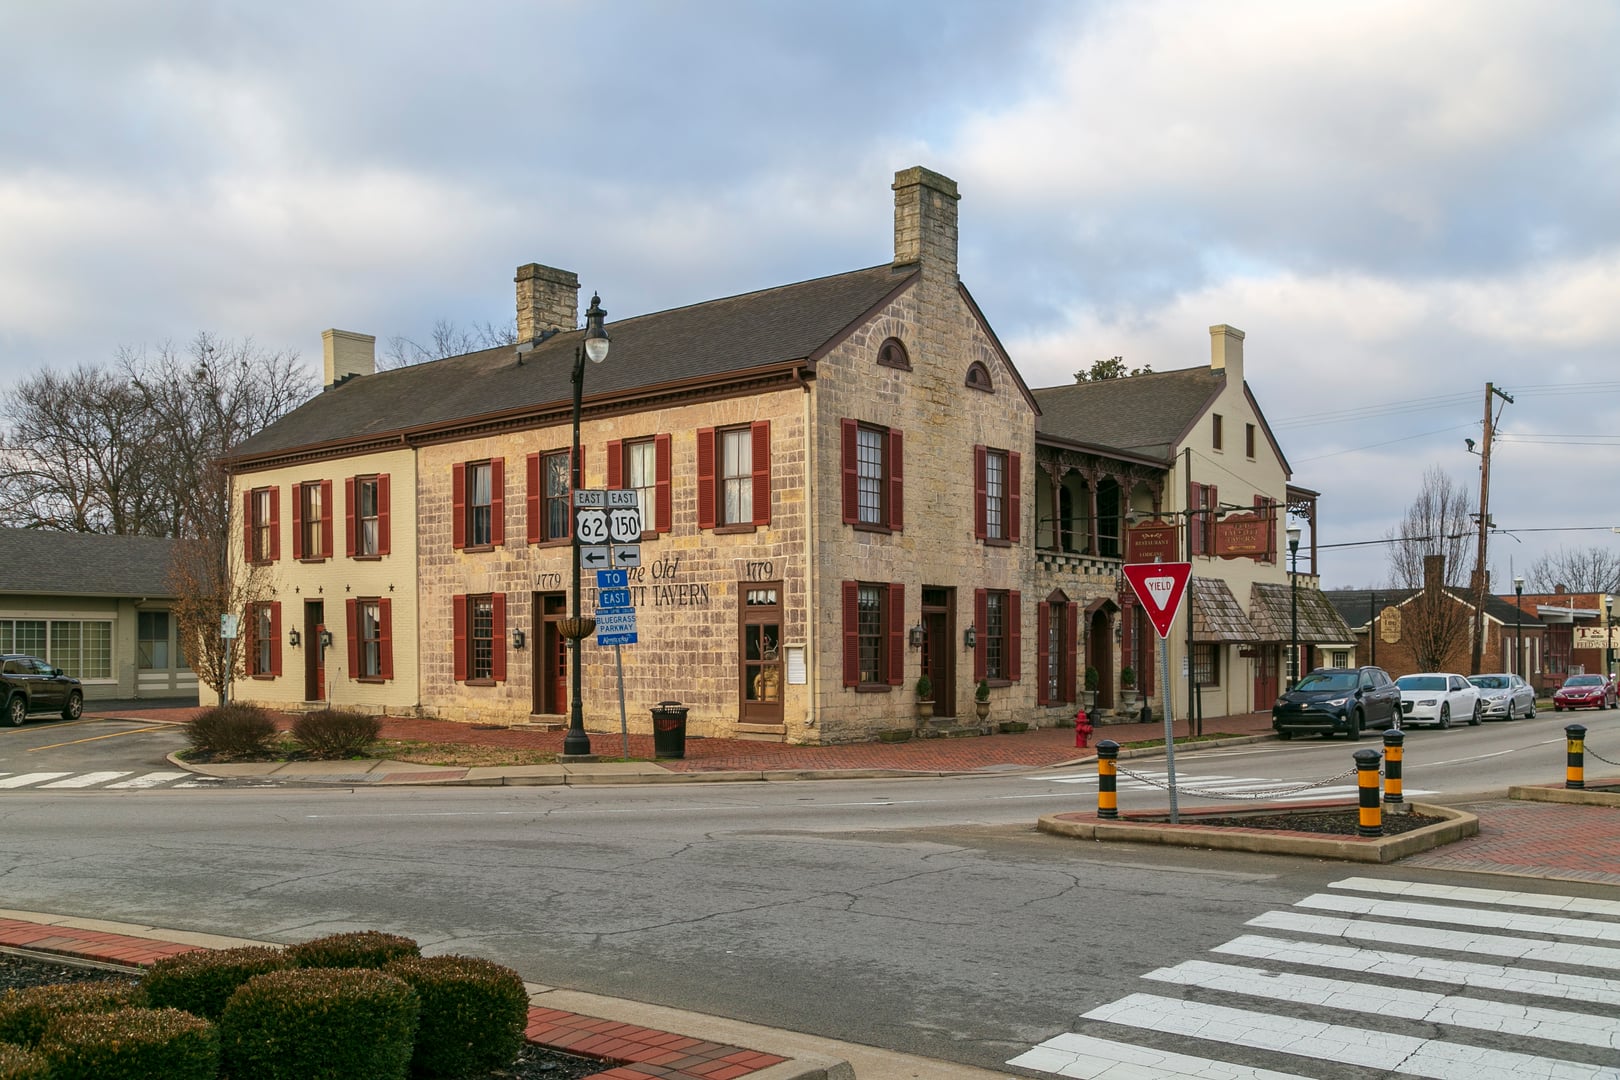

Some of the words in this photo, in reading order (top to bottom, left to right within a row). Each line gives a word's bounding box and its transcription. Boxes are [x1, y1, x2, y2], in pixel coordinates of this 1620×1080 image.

[579, 493, 601, 503] EAST
[611, 493, 633, 503] EAST
[582, 518, 604, 537] 62
[615, 516, 637, 536] 150
[652, 558, 680, 579] Old
[746, 561, 773, 581] 1779
[537, 573, 562, 590] 1779
[605, 573, 620, 584] TO
[1149, 581, 1172, 591] YIELD
[603, 592, 625, 604] EAST
[653, 583, 709, 606] TAVERN
[596, 615, 636, 625] BLUEGRASS
[600, 624, 634, 633] PARKWAY
[1576, 627, 1591, 638] T
